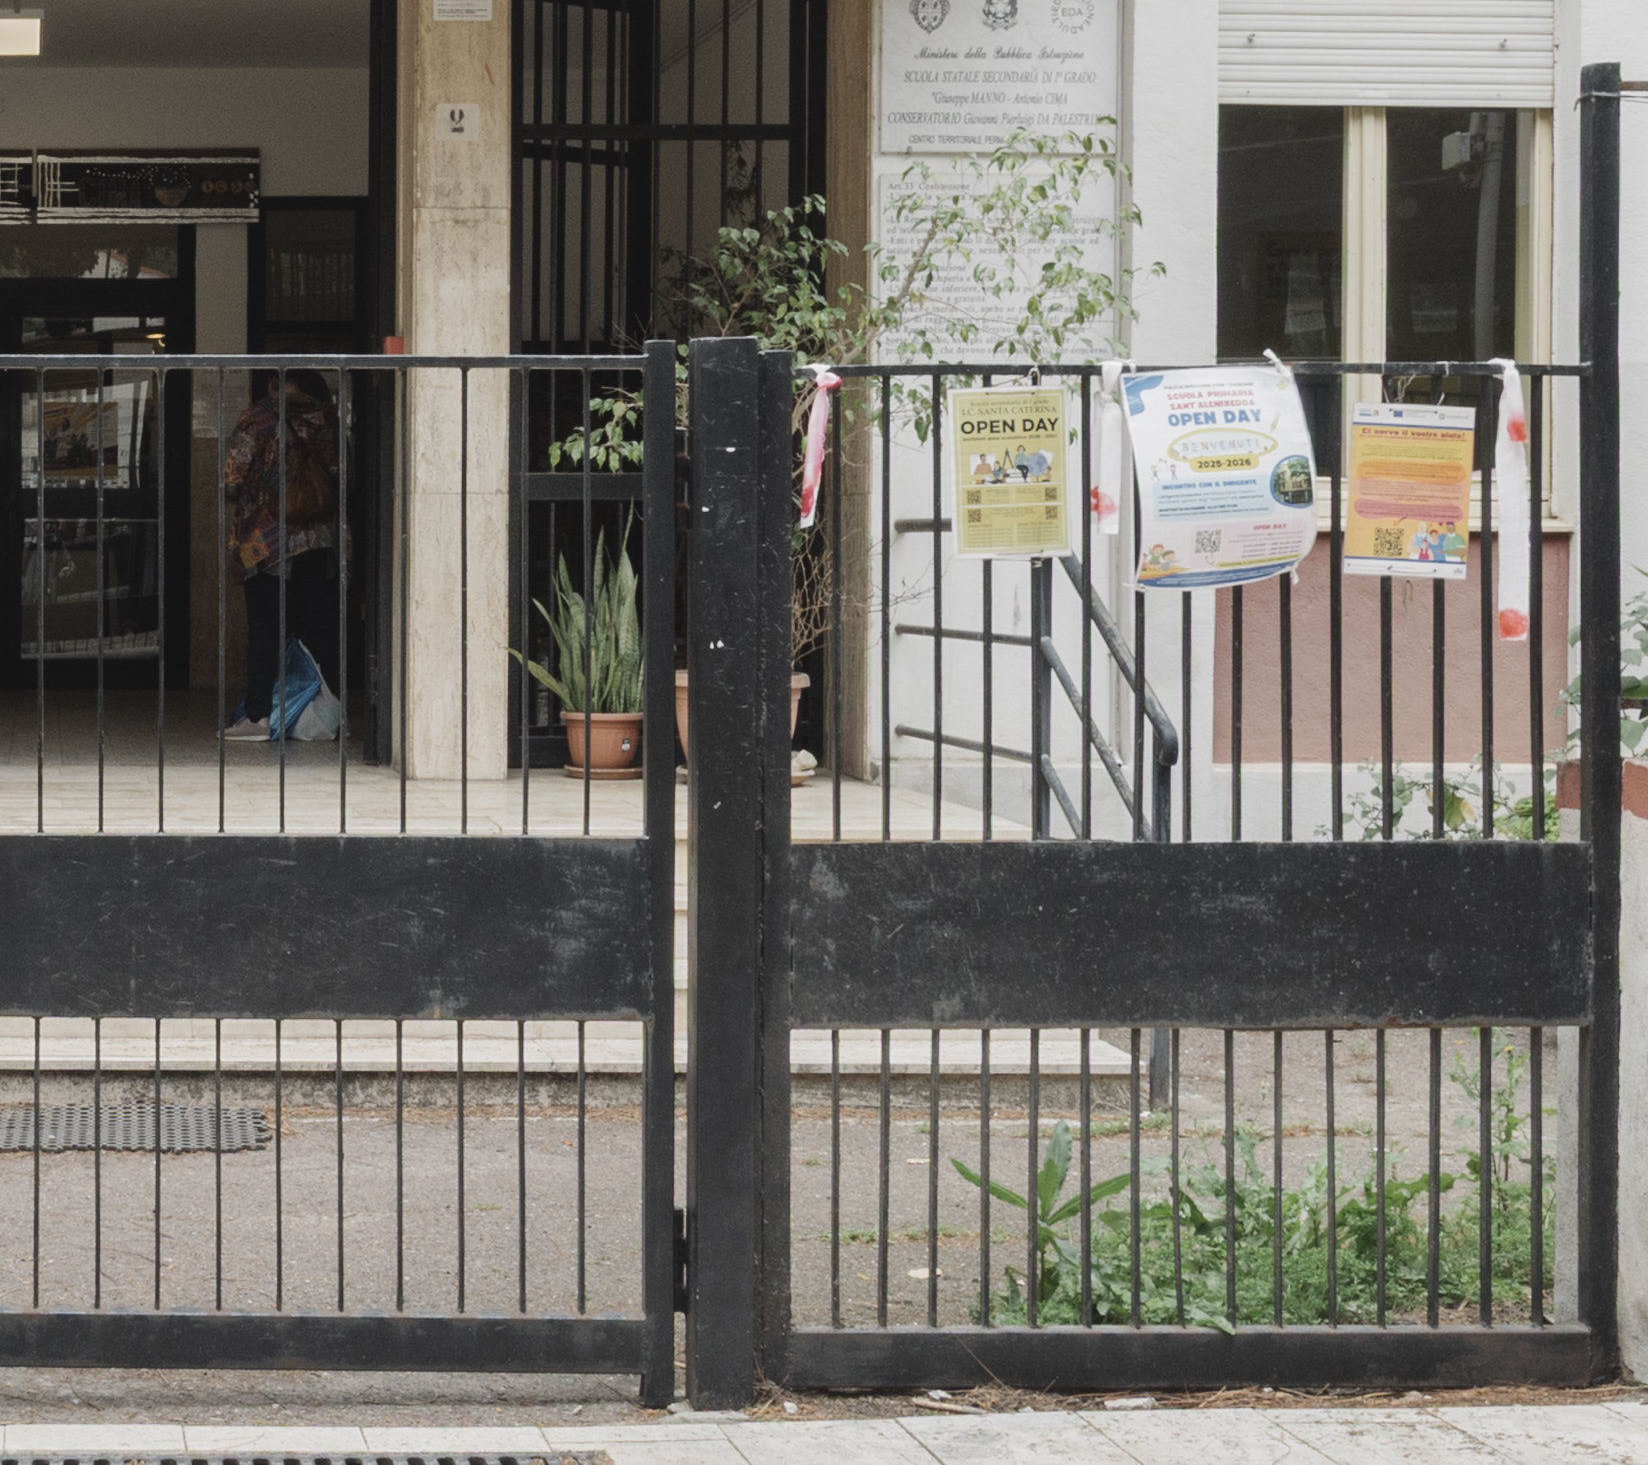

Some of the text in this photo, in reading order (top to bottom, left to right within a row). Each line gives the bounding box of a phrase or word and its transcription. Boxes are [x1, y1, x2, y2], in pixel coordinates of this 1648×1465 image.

[1061, 8, 1084, 17] EDA
[914, 45, 1084, 65] Ministero della Pubblica Istruzione
[903, 71, 939, 83] SCUOLA
[942, 71, 980, 83] STATALE
[1041, 71, 1053, 83] DI
[1064, 71, 1097, 83] GRADO
[970, 92, 1006, 104] MANNO
[1013, 93, 1043, 105] Antonio
[1045, 92, 1068, 105] CIMA
[887, 112, 961, 125] CONSERVATORIO
[963, 112, 998, 125] Giovanni
[1001, 112, 1035, 127] Pierluigi
[1037, 113, 1050, 125] DA
[908, 135, 982, 144] CENTRO TERRITORIALE
[1167, 389, 1255, 401] SCUOLA PRIMARIA
[978, 407, 1009, 416] SANTA
[1011, 406, 1057, 414] CATERINA
[1168, 409, 1261, 427] OPEN DAY
[960, 417, 1059, 435] OPEN DAY
[1411, 430, 1438, 438] vostro
[1182, 438, 1260, 452] BENVENUTI
[1197, 458, 1251, 469] 2025-2026
[1162, 482, 1197, 491] INCONTRO
[1222, 479, 1257, 487] DIRIGENTE
